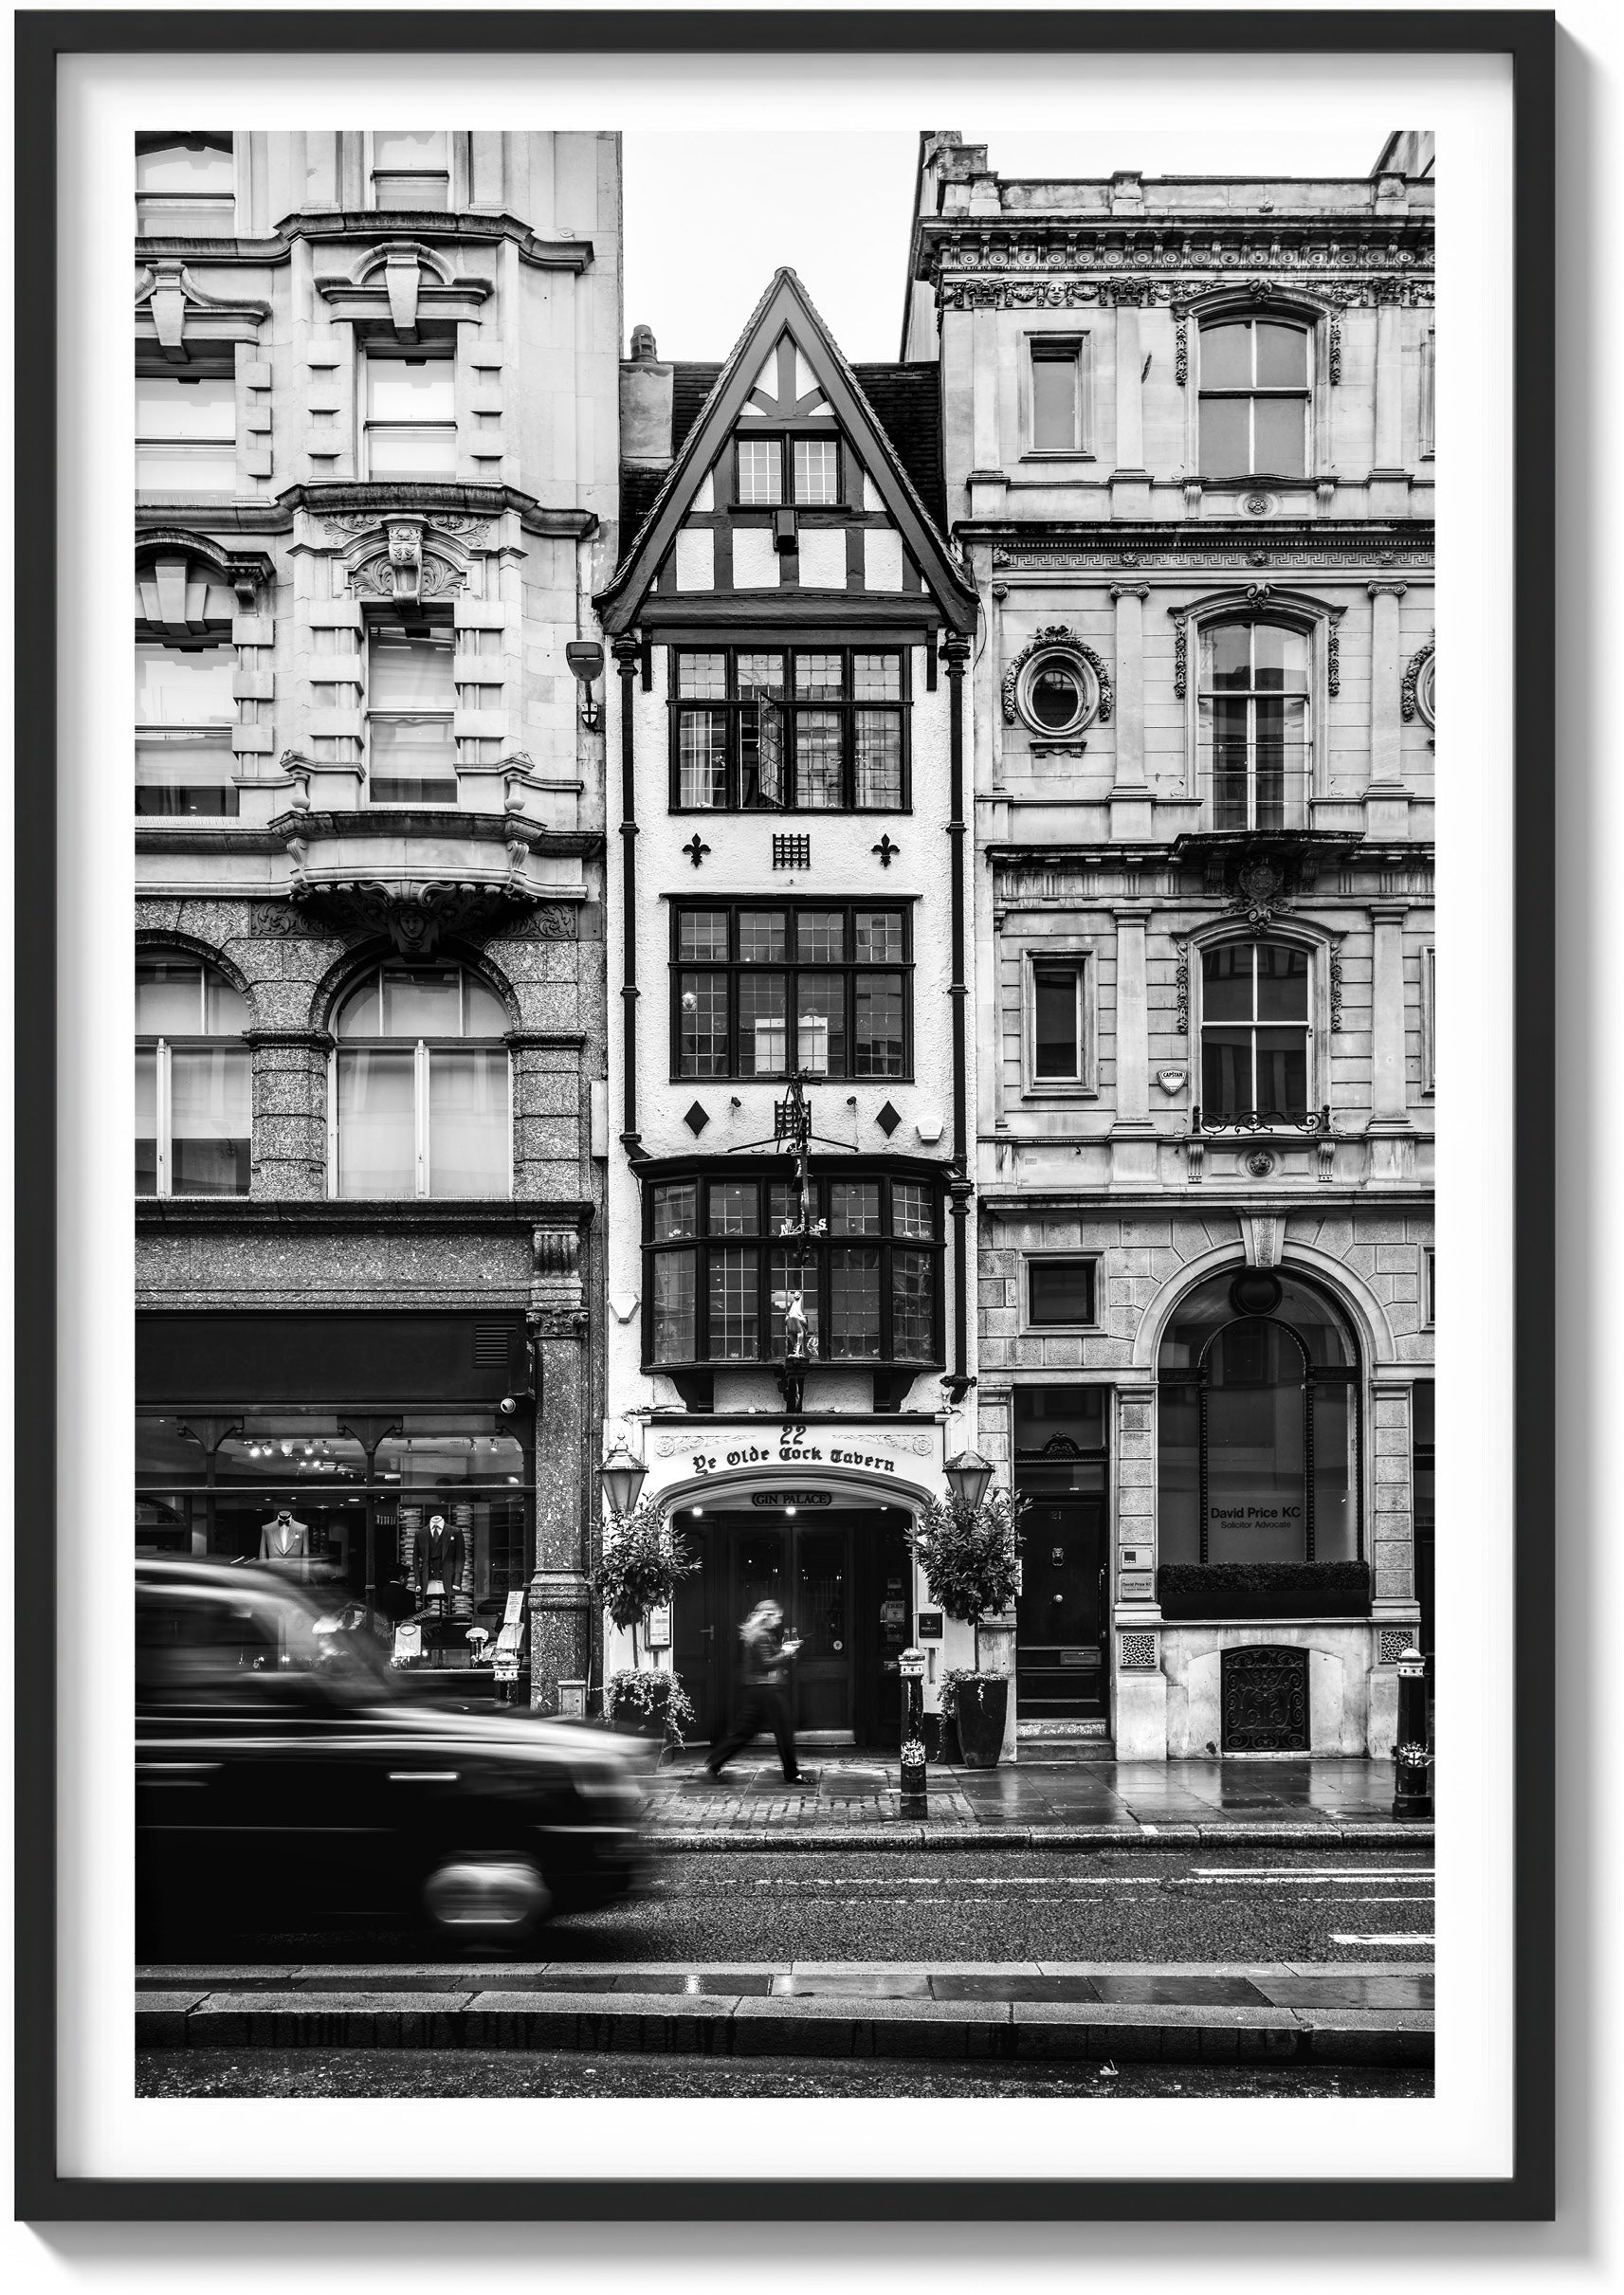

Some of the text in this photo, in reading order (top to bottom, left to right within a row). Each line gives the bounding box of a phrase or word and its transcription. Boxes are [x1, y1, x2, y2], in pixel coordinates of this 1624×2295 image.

[779, 1425, 807, 1446] 22
[692, 1446, 896, 1475] Ye Olde Cock Tavern
[756, 1494, 828, 1504] GIN PALACE
[1050, 1510, 1062, 1520] 21
[1211, 1506, 1302, 1519] David Price KC
[1254, 1521, 1291, 1529] Advocate
